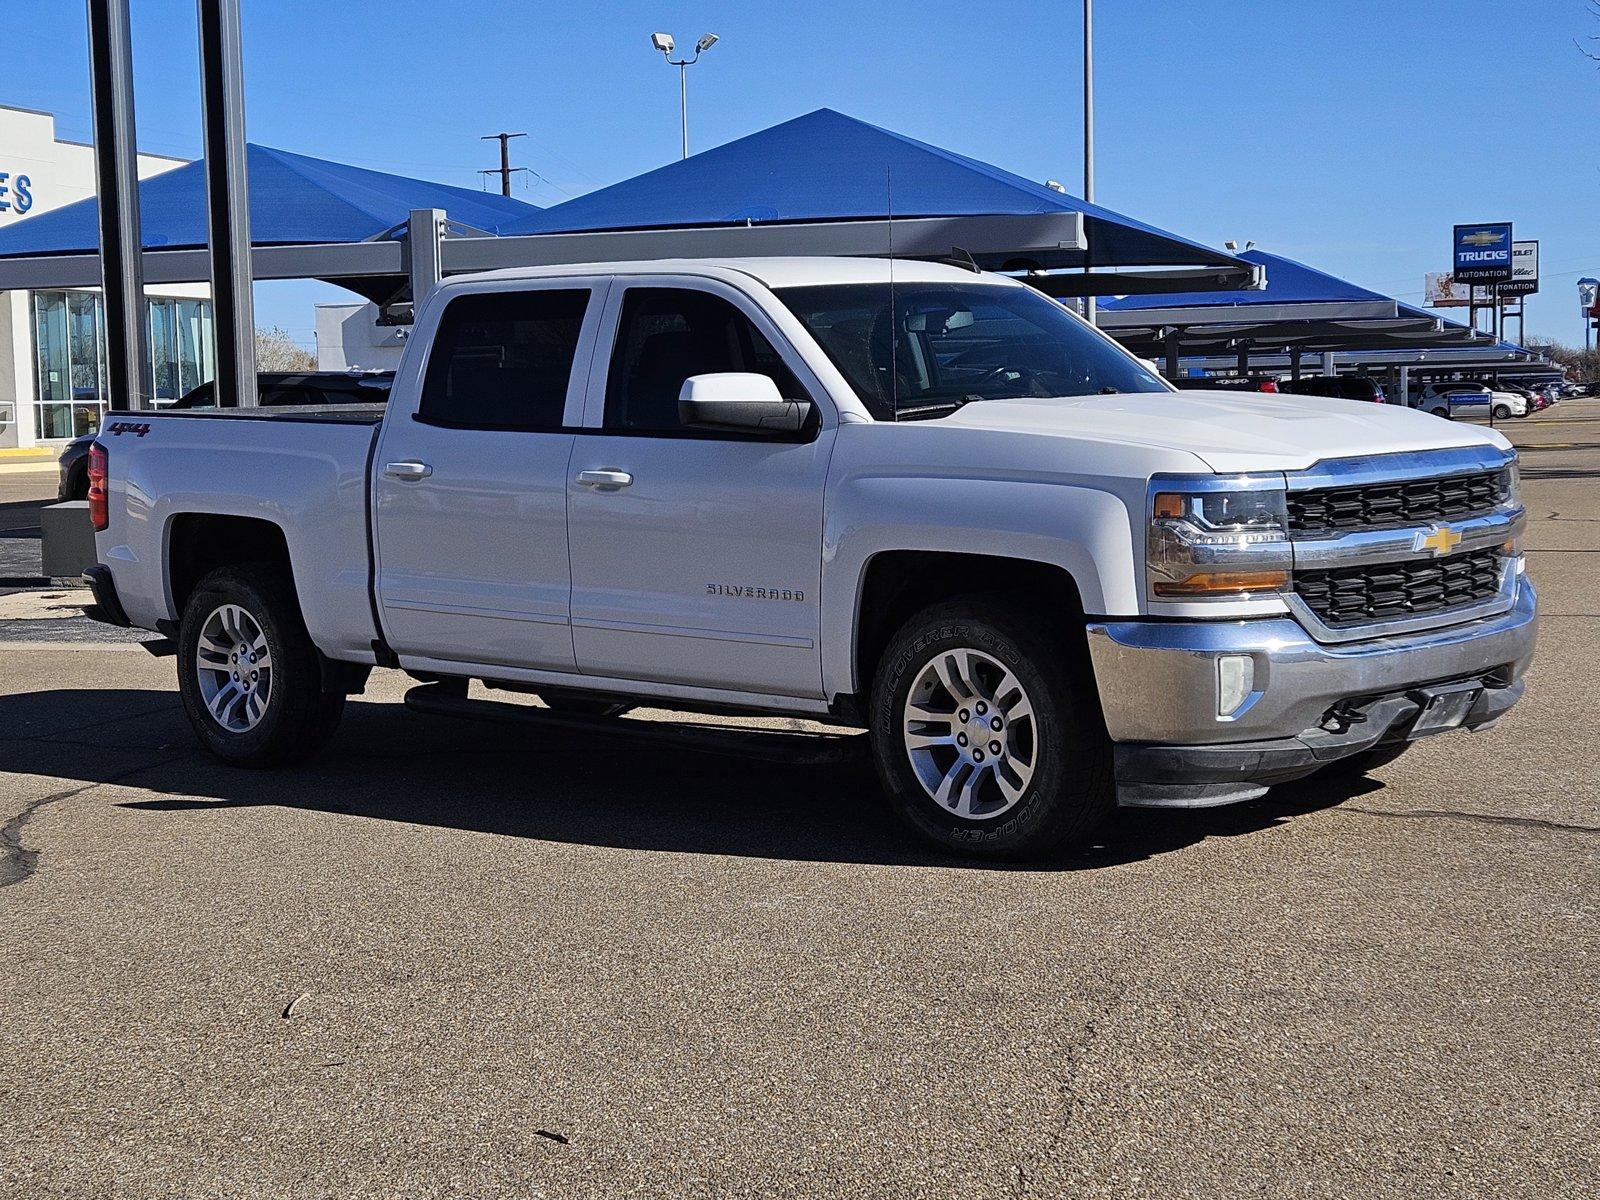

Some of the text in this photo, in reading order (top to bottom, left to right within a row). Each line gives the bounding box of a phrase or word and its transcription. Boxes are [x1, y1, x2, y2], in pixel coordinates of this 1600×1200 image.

[1458, 250, 1508, 262] TRUCKS
[1458, 270, 1508, 279] AUTONATION
[706, 583, 804, 601] SILVERADO
[881, 625, 969, 735] DISCOVERER
[949, 790, 1041, 842] COOPER
